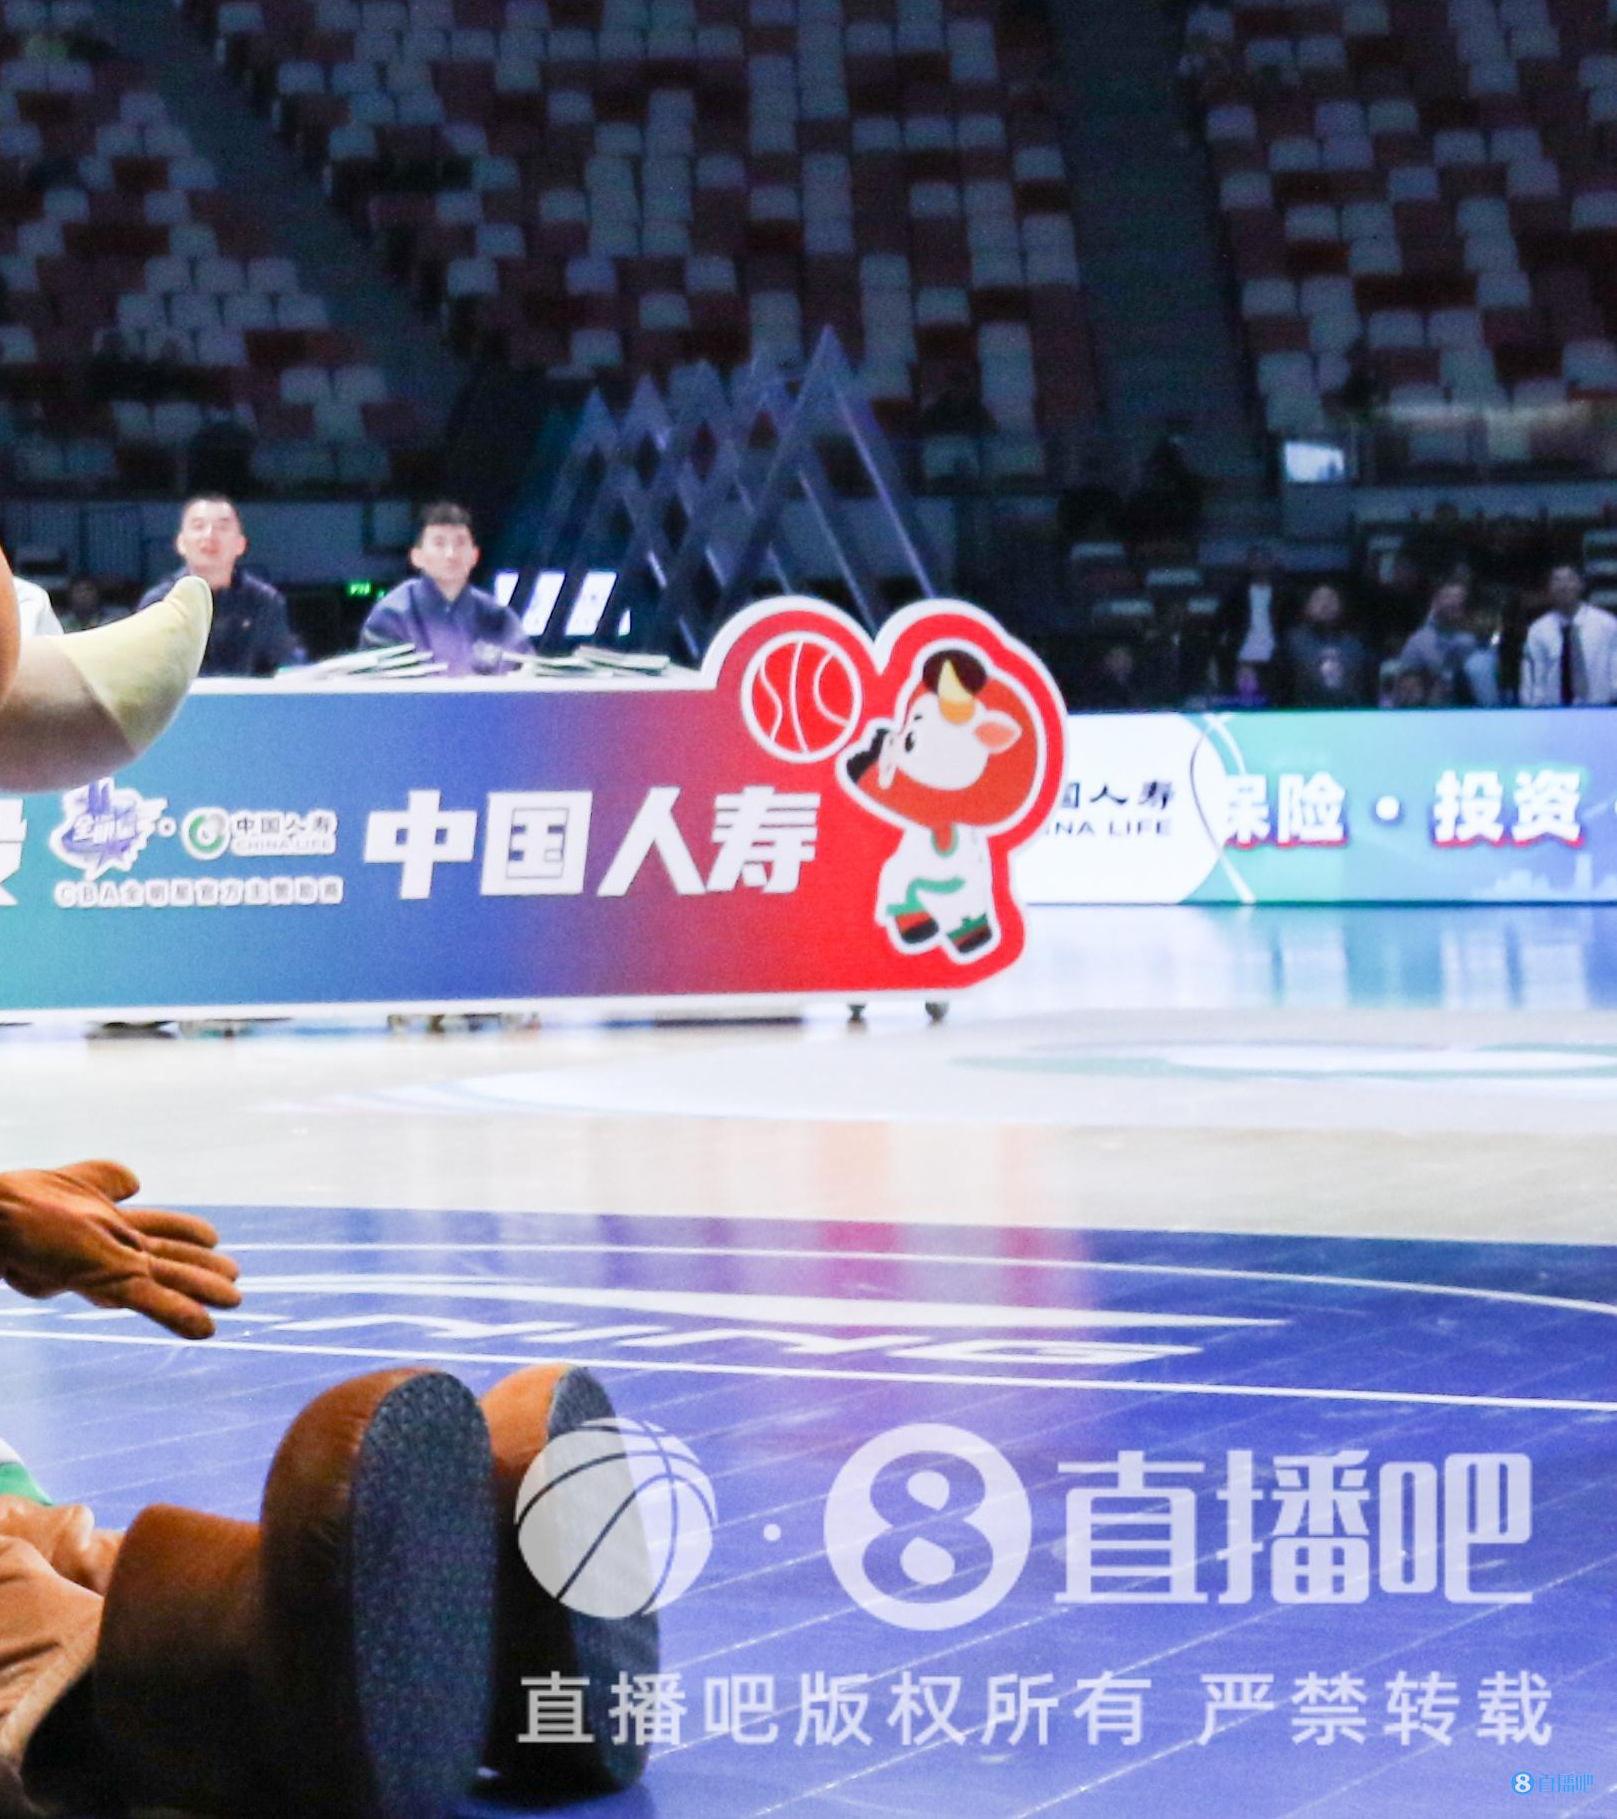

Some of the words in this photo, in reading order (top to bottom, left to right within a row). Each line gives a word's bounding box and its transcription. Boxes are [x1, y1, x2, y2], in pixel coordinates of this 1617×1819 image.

[236, 816, 330, 834] 中国人寿
[363, 785, 822, 900] 中国人寿
[1433, 768, 1586, 848] 投资
